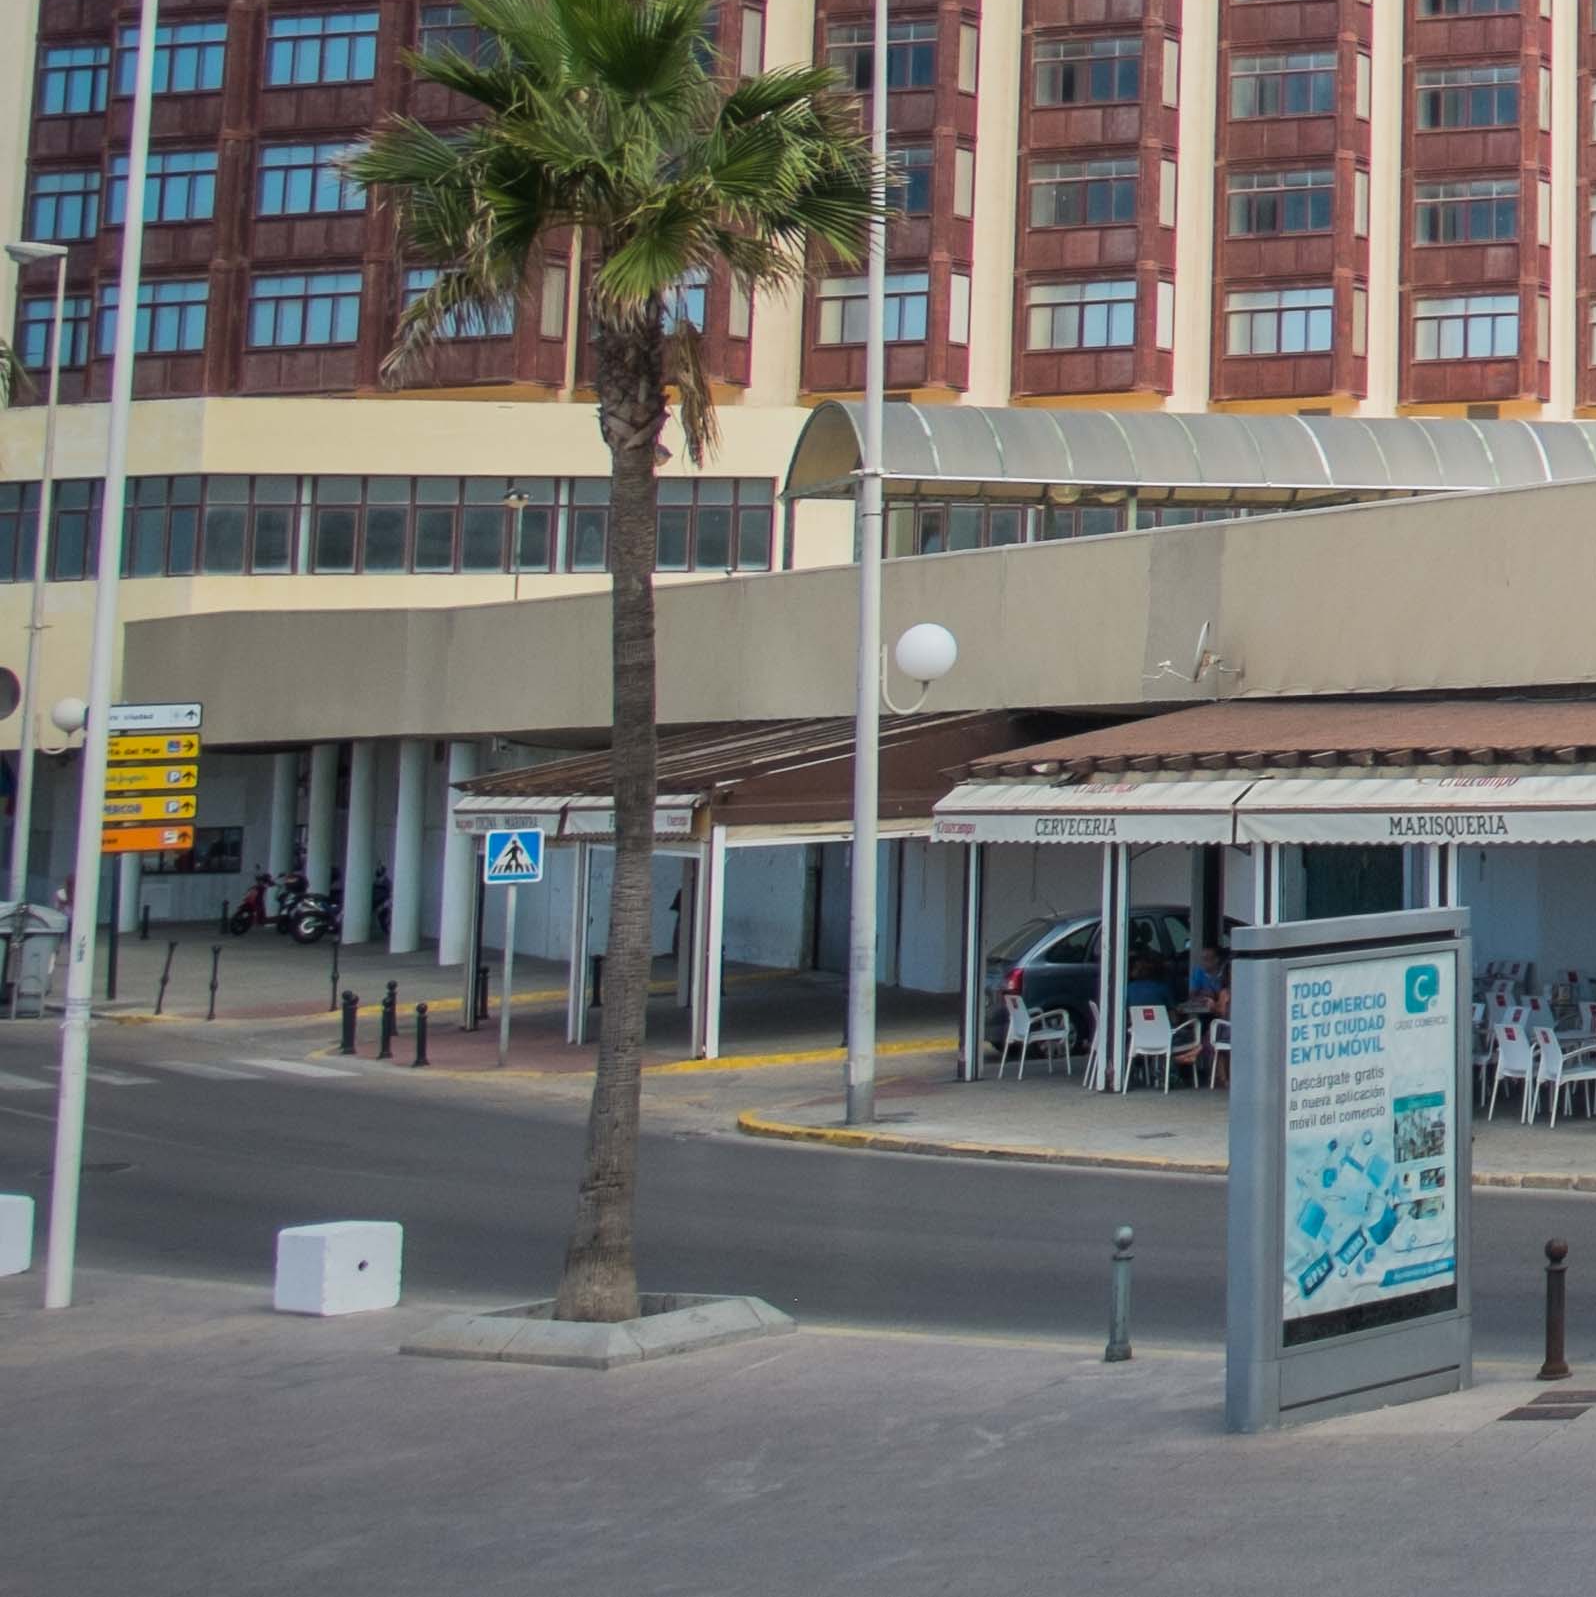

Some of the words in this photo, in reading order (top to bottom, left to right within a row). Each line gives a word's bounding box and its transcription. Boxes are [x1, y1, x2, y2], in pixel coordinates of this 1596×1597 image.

[1035, 817, 1118, 838] CERVECERIA
[1389, 815, 1510, 838] MARISQUERIA
[1292, 980, 1333, 1000] TODO
[1291, 1002, 1309, 1021] EL
[1311, 993, 1387, 1018] COMERCIO
[1291, 1025, 1310, 1043] DE
[1312, 1021, 1331, 1039] TU
[1334, 1015, 1386, 1037] CIUDAD
[1290, 1046, 1312, 1065] EN
[1314, 1043, 1336, 1061] TU
[1338, 1033, 1386, 1057] MÓVIL
[1291, 1071, 1351, 1093] Descárgate
[1355, 1066, 1385, 1085] gratis
[1289, 1098, 1299, 1111] la
[1301, 1095, 1331, 1109] nueva
[1319, 1110, 1336, 1126] del
[1339, 1103, 1386, 1123] comercio
